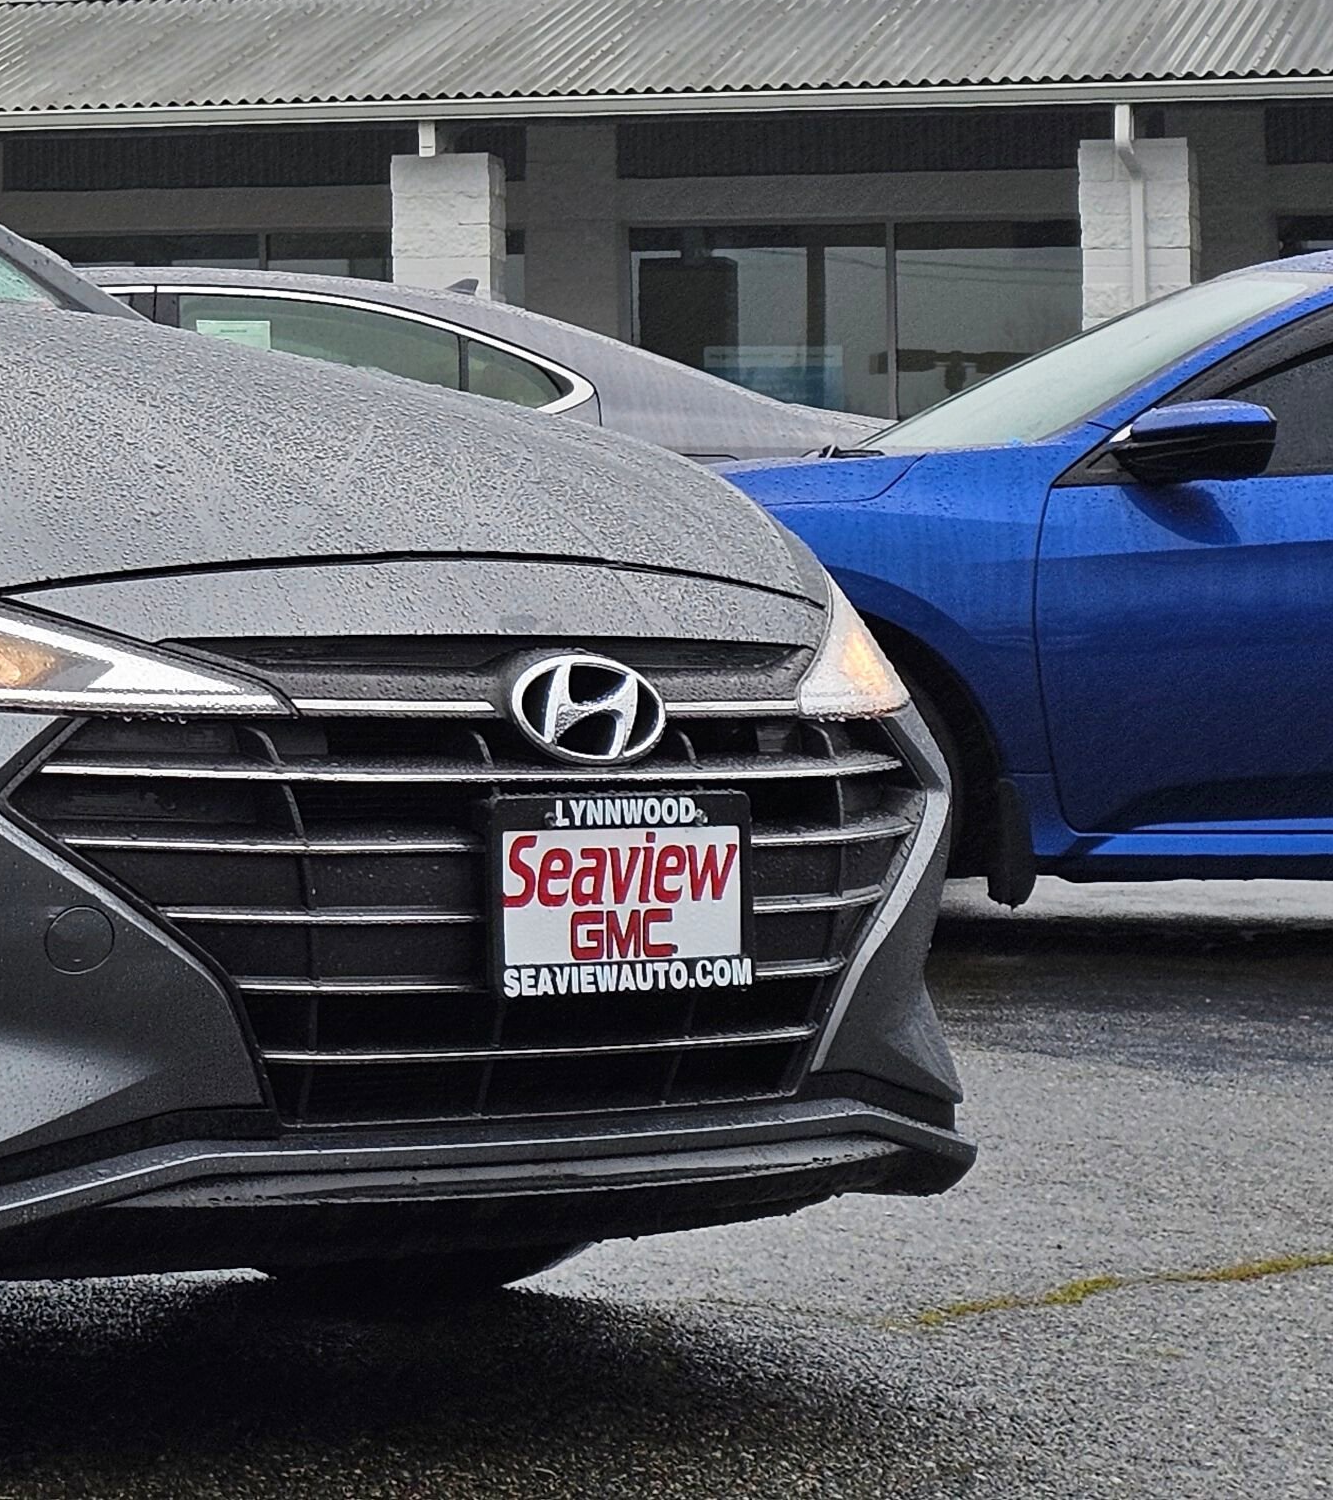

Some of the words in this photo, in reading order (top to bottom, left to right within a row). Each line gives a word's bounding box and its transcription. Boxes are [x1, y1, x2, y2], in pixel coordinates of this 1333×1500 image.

[555, 797, 696, 826] LYNNWOOD
[501, 831, 738, 908] Seaview
[570, 908, 678, 961] GMC
[503, 958, 753, 998] SEAVIEWAUTO.COM
